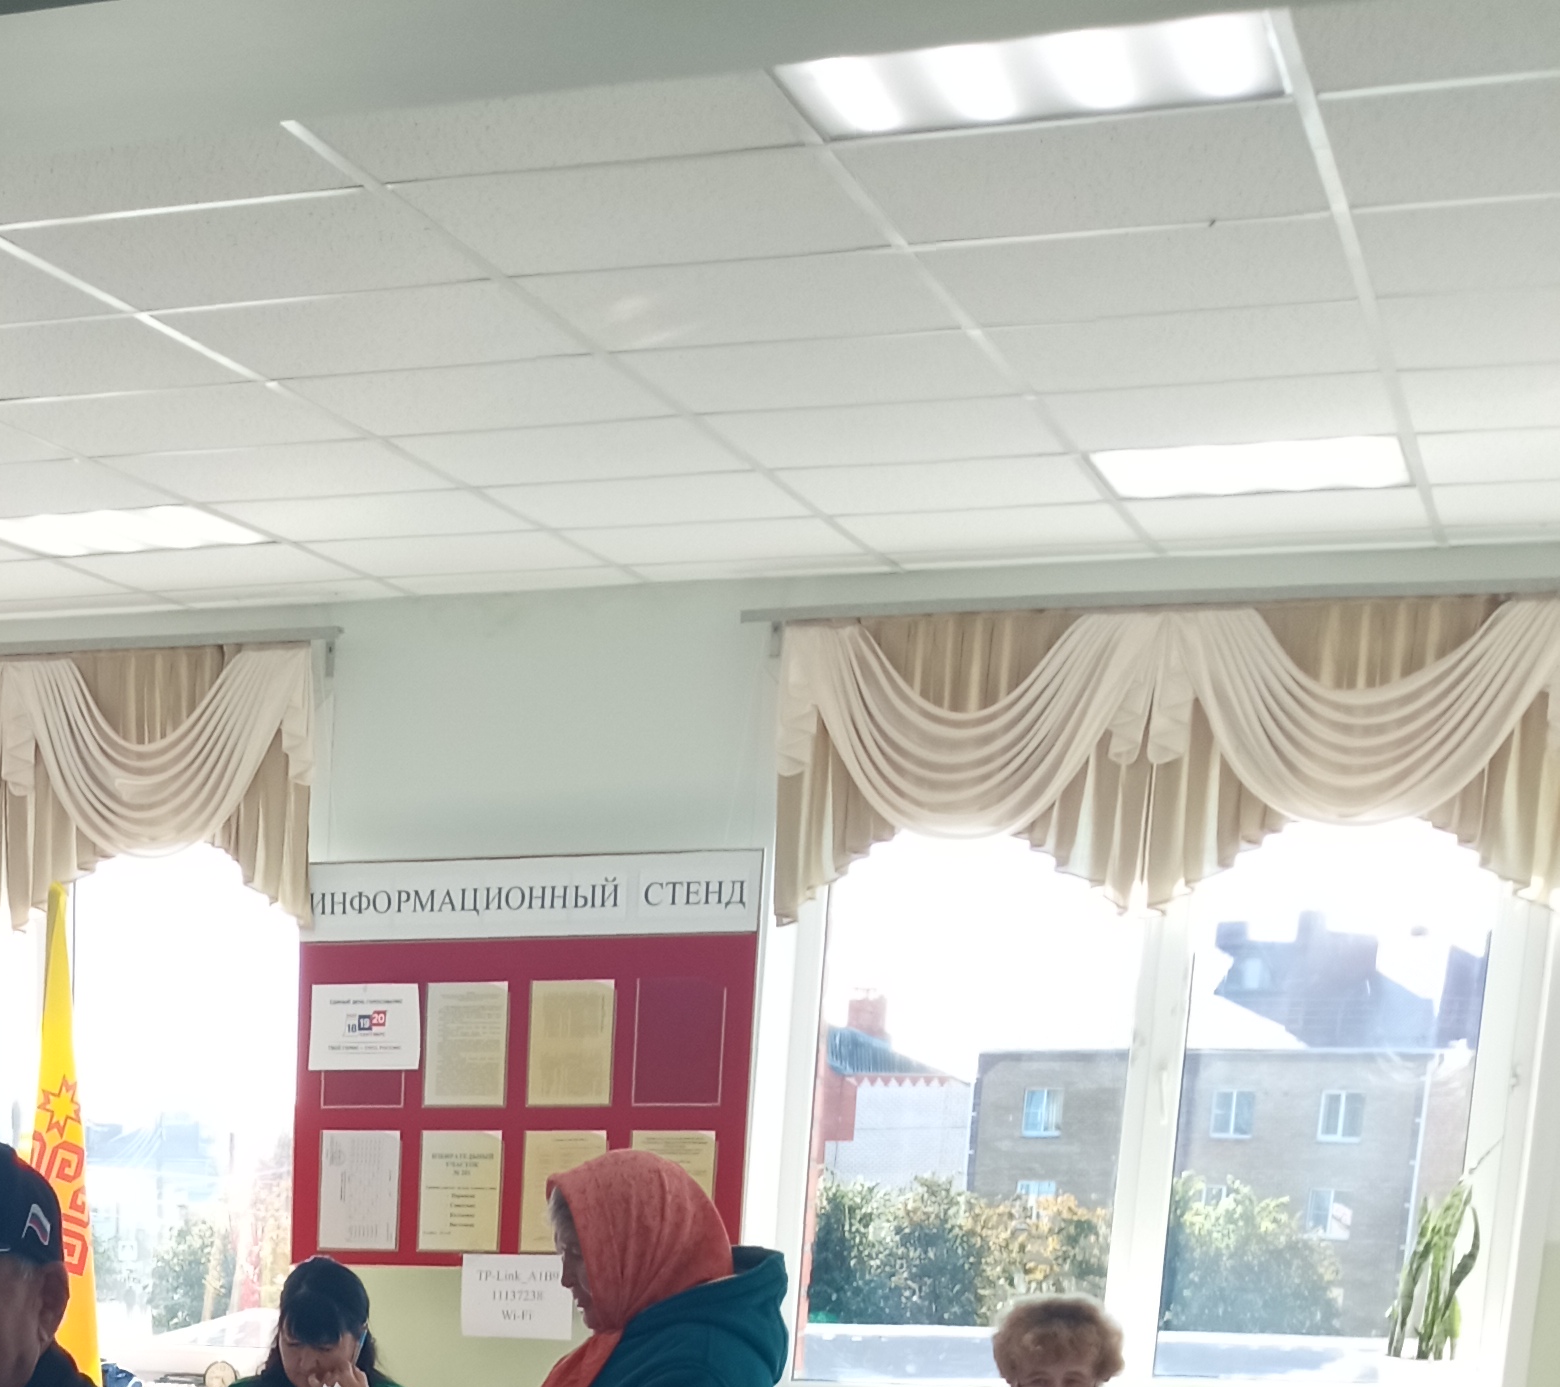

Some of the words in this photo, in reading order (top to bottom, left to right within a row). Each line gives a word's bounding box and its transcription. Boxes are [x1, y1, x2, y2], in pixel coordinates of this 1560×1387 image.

[310, 876, 619, 917] ИНФОРМАЦИОННЫЙ
[643, 879, 747, 910] СТЕНД
[371, 1013, 385, 1024] 20
[501, 1309, 533, 1321] Wi-Fi
